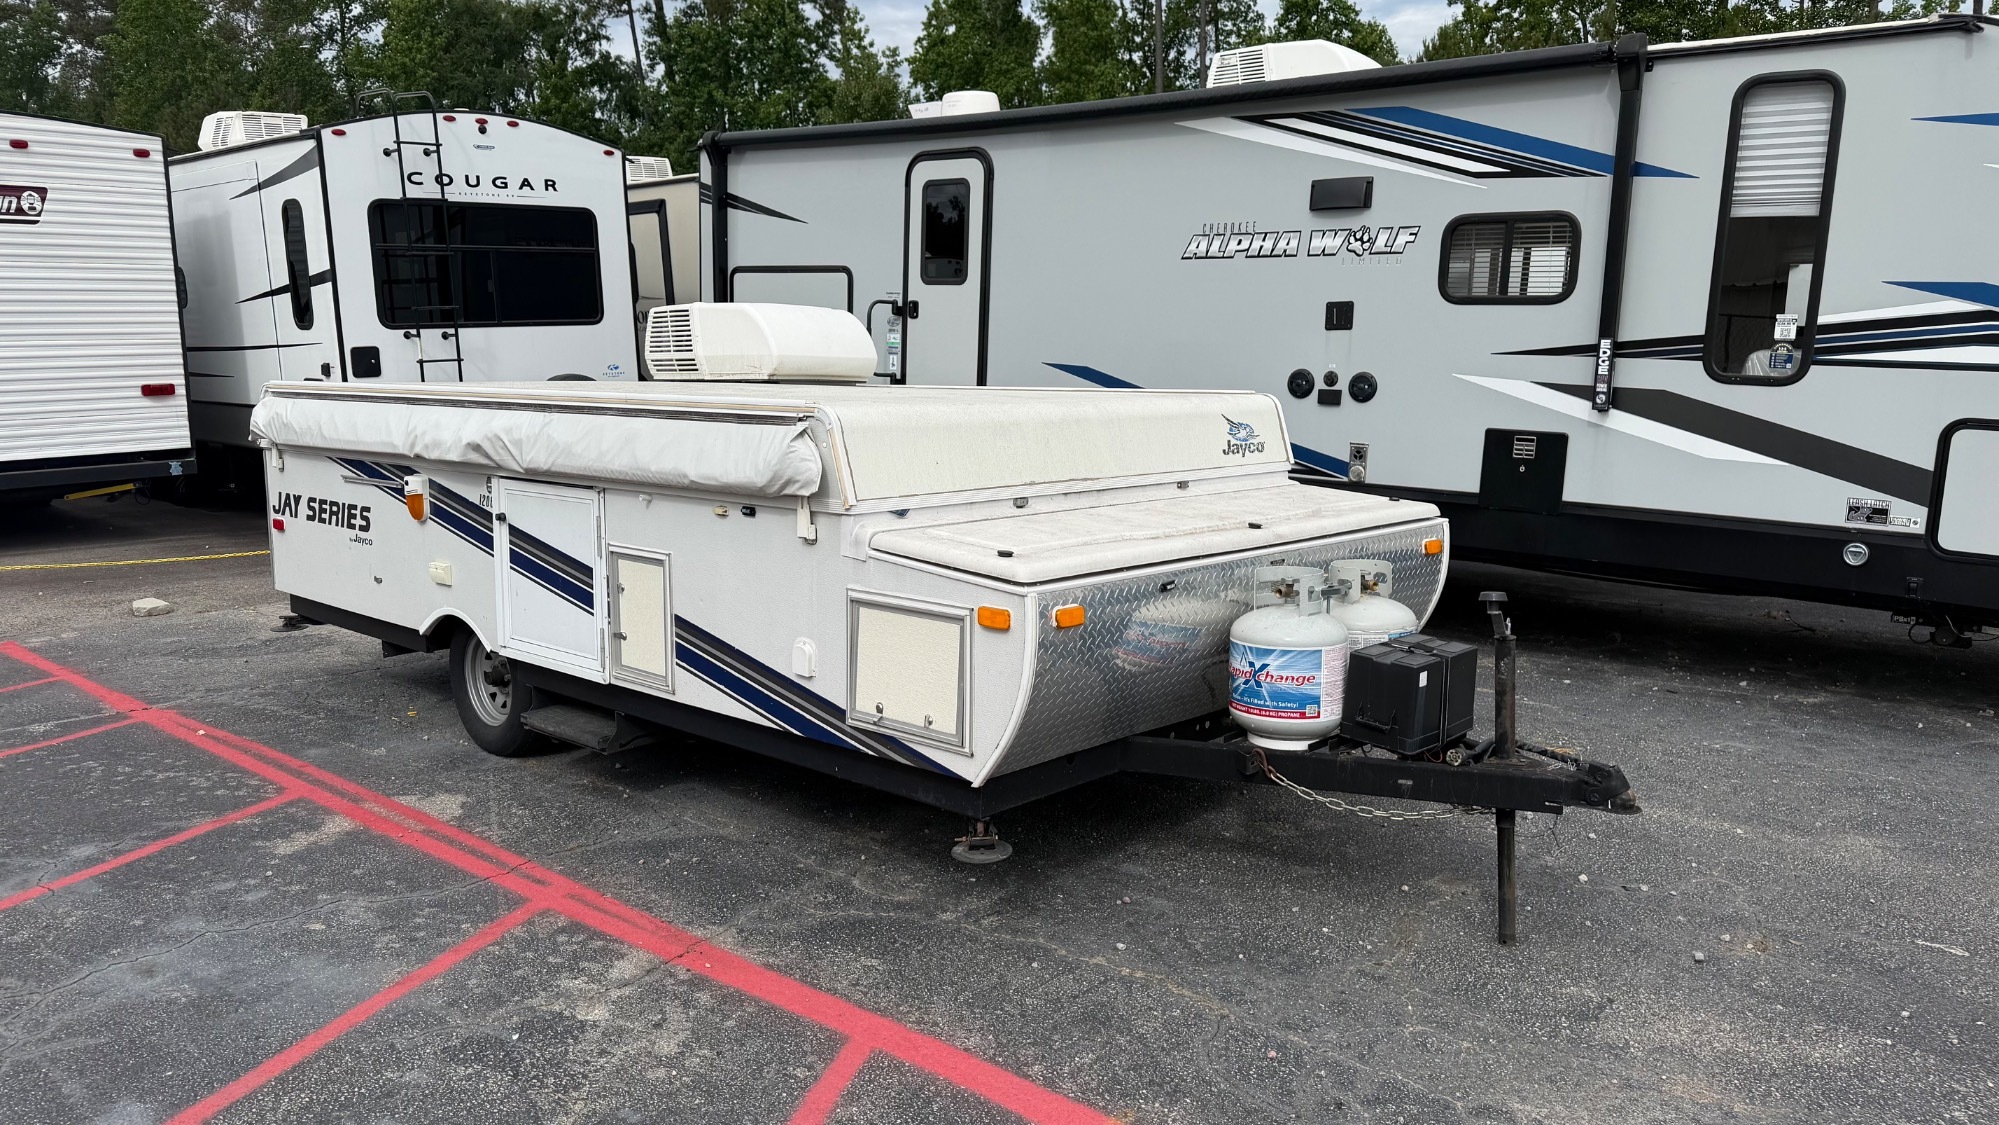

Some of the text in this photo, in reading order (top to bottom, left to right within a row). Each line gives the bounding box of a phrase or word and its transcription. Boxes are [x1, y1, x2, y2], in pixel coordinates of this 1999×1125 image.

[407, 171, 558, 192] COUGAR
[1202, 221, 1258, 234] CHEROKEE
[1181, 230, 1302, 260] ALPHA
[1341, 256, 1403, 266] LIMITED
[1597, 339, 1612, 375] EDGE
[1222, 439, 1265, 458] Jayco
[272, 491, 372, 533] JAY SERIES
[353, 533, 373, 546] Jayco
[1278, 701, 1299, 709] Safety!
